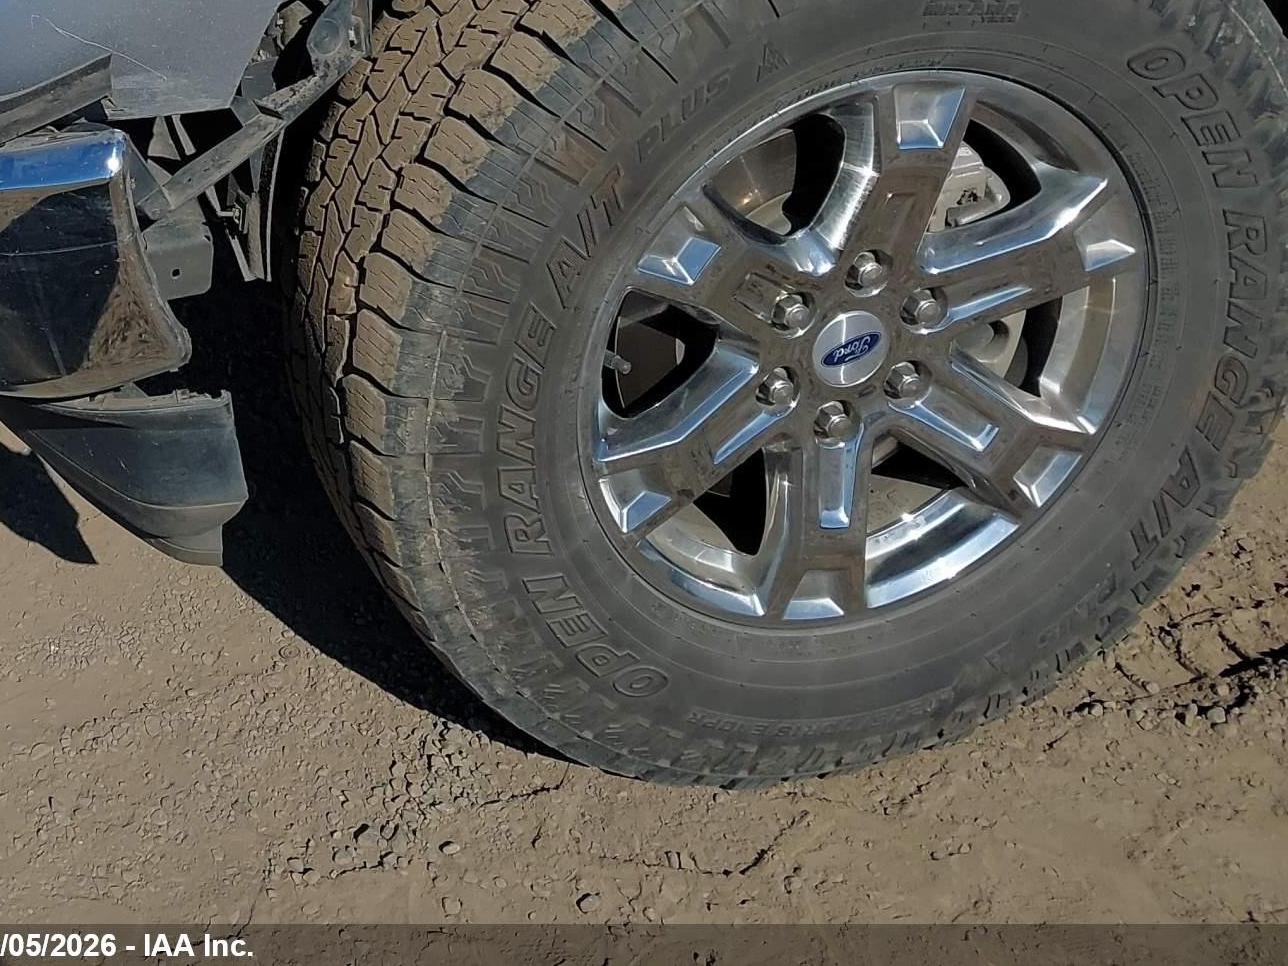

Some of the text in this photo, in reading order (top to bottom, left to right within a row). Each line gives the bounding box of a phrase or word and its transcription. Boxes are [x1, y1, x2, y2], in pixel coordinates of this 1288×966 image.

[1126, 46, 1260, 189] OPEN
[546, 162, 624, 310] A/T
[831, 335, 872, 363] Ford
[1194, 208, 1269, 452] RANGE
[497, 301, 556, 556] RANGE
[1128, 445, 1202, 572] A/T
[521, 573, 670, 698] OPEN
